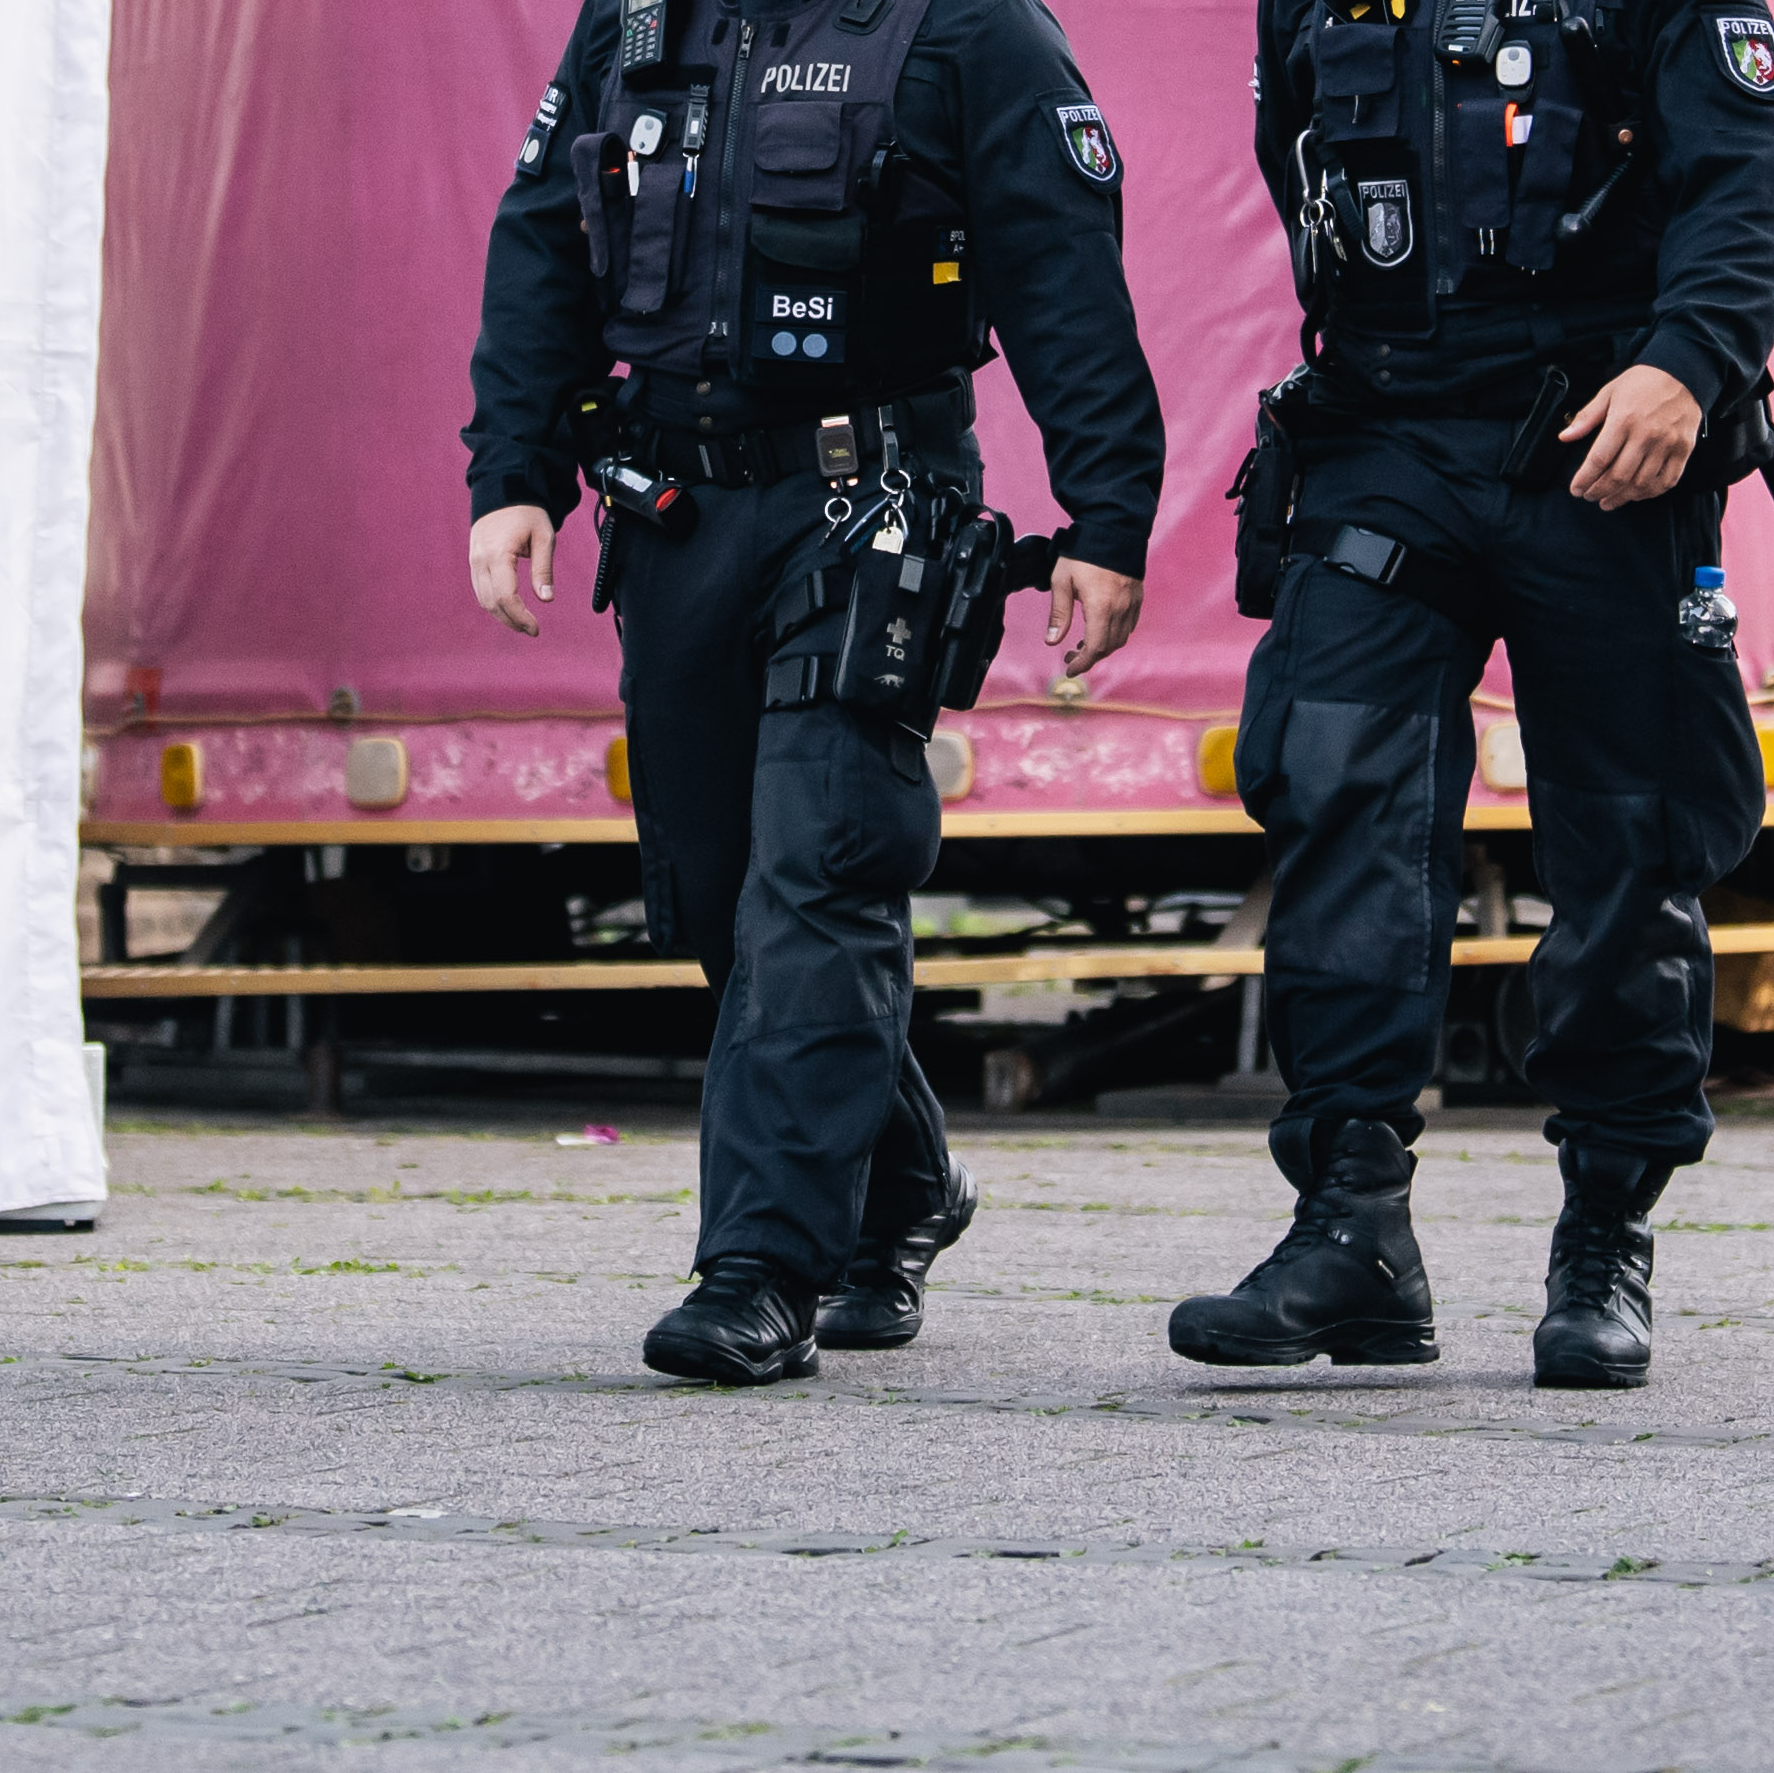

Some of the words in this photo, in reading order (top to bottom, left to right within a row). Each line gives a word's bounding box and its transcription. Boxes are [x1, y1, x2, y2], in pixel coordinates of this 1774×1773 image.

[1723, 21, 1770, 35] POLIZE
[760, 63, 851, 94] POLIZEI
[1060, 108, 1100, 123] POLIZE
[1362, 184, 1406, 199] POLIZEI
[772, 294, 833, 320] BeSi
[886, 644, 905, 661] TQ
